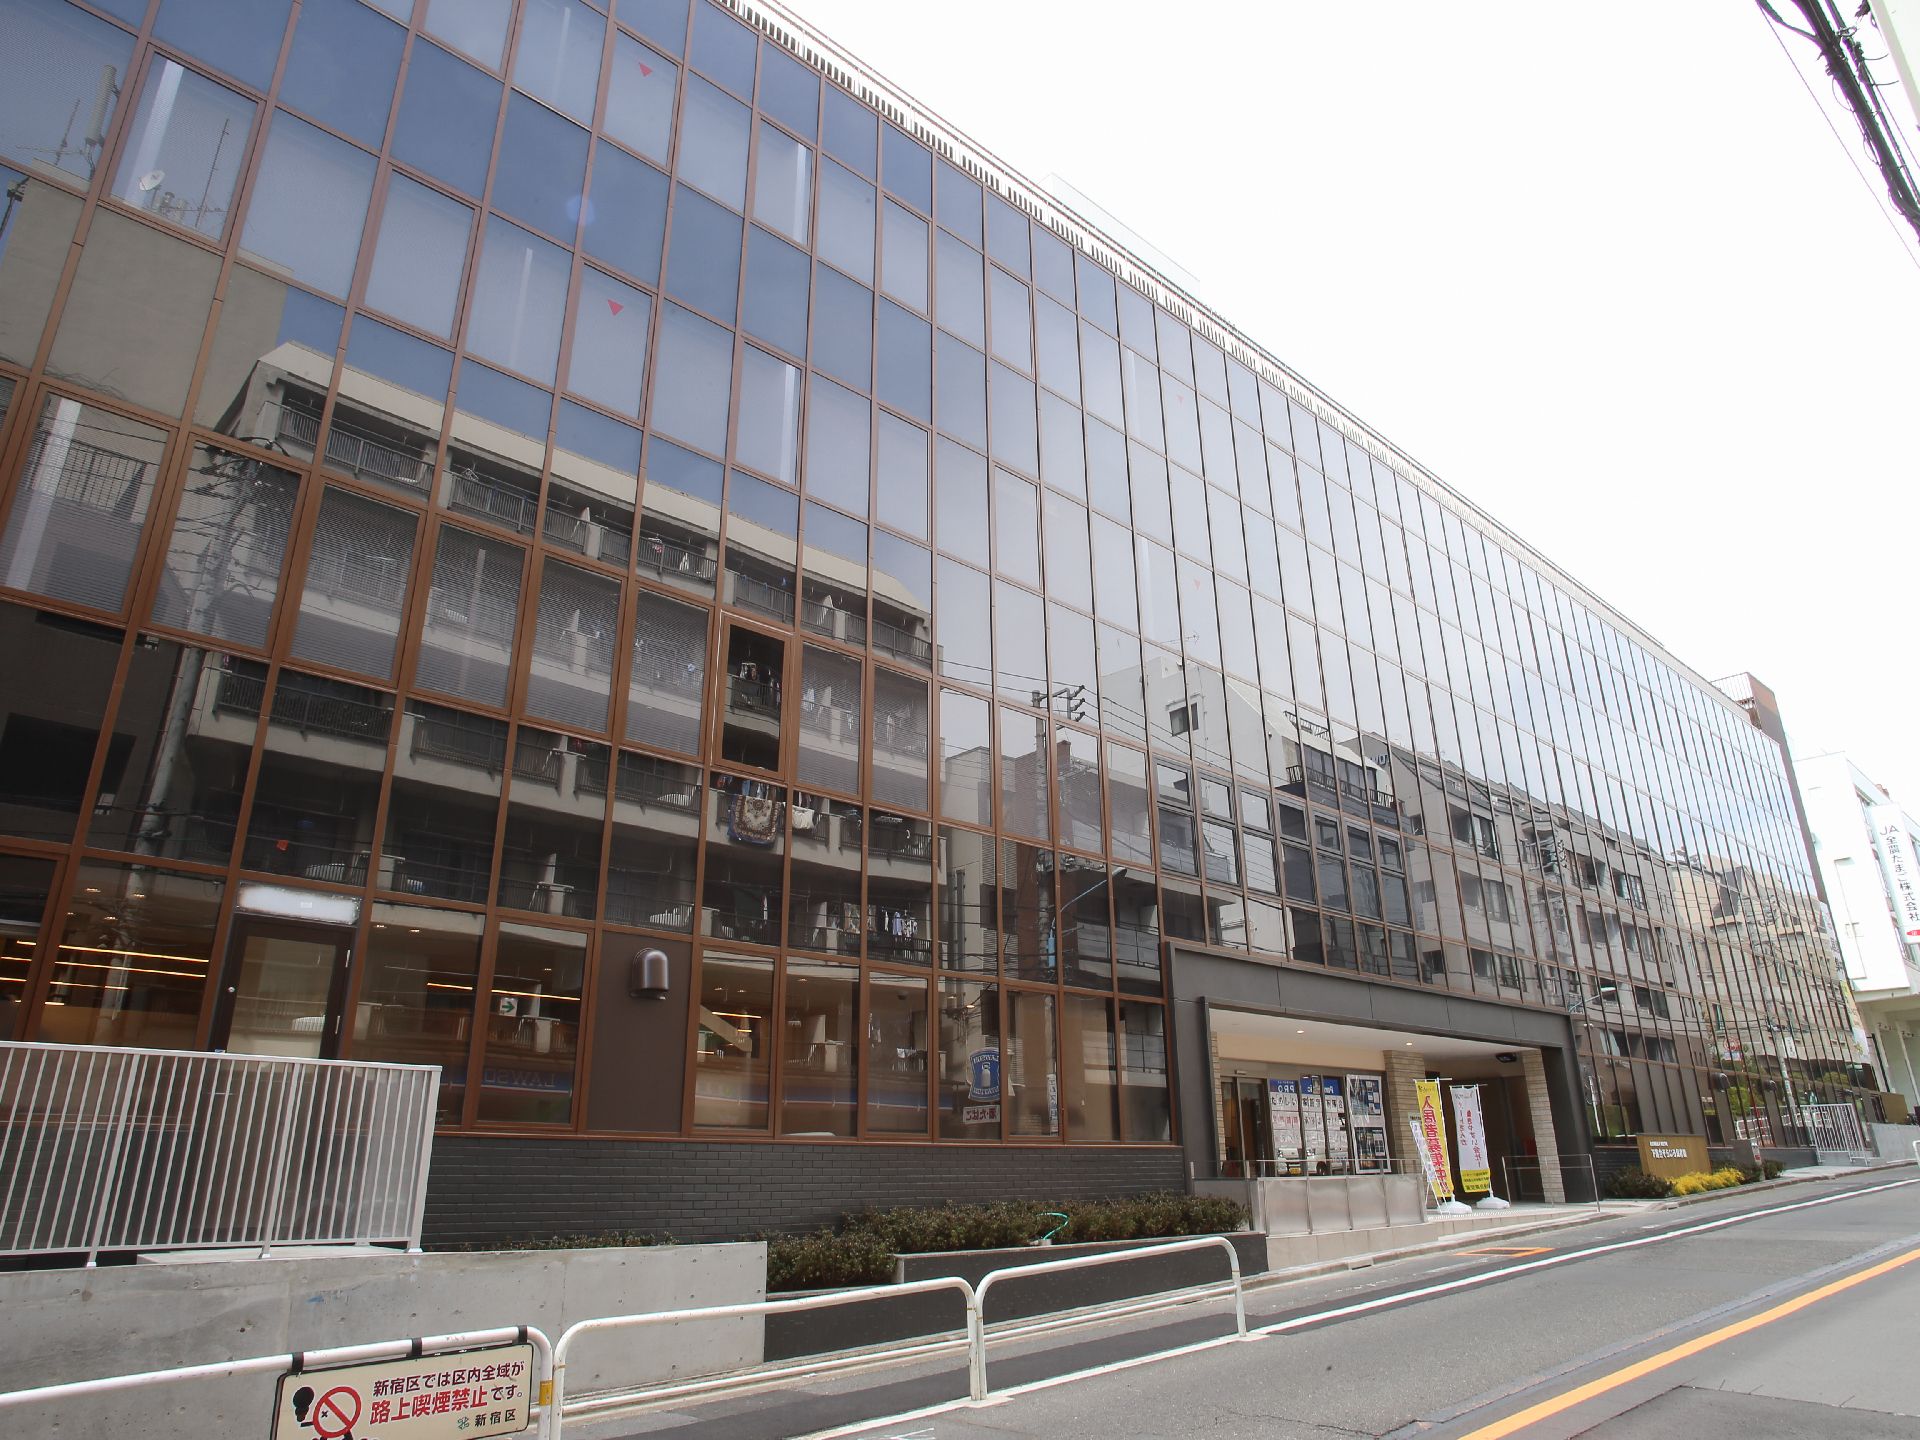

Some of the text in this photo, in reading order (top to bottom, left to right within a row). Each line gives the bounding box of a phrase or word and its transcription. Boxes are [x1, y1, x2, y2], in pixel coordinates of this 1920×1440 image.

[373, 1360, 525, 1397] 新宿区では区内全域が
[369, 1384, 524, 1425] 路上喫煙禁止です。
[474, 1408, 517, 1428] 新宿区
